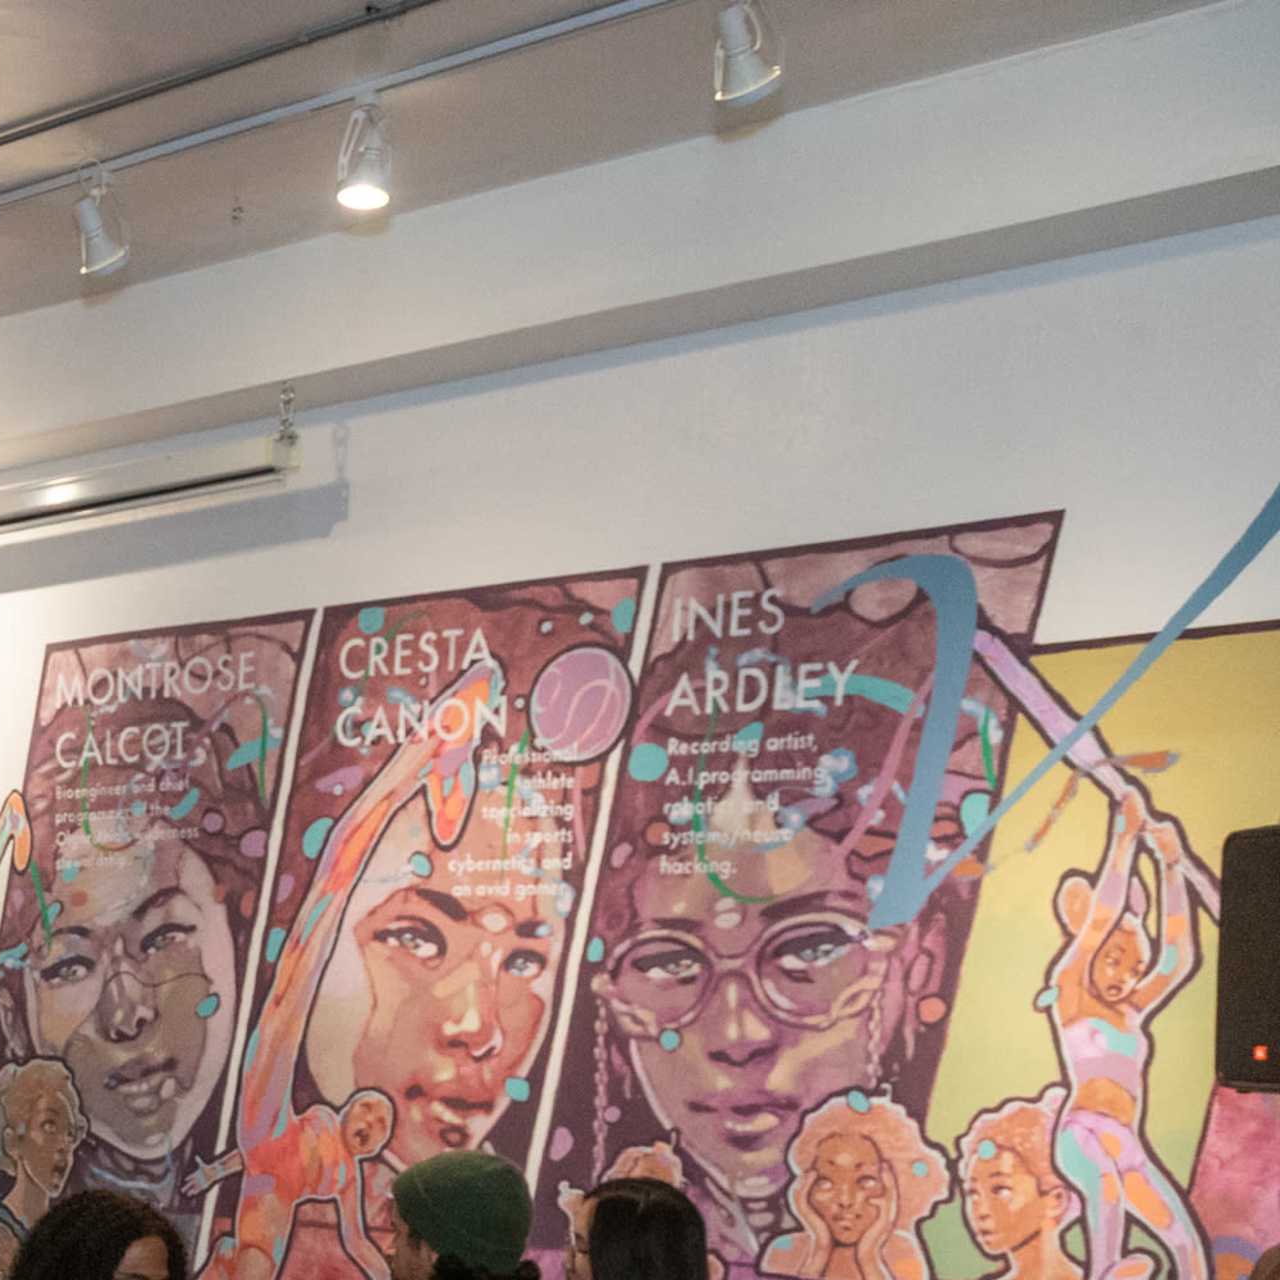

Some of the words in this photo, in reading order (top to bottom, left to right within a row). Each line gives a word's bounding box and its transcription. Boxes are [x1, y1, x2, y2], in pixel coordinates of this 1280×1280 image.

[672, 588, 786, 642] INES
[340, 628, 496, 680] CRESTA
[55, 652, 257, 709] MONTROSE
[665, 659, 859, 717] ARDLEY
[56, 722, 191, 768] CALCOT
[336, 695, 507, 747] CANON
[666, 736, 760, 758] Recording
